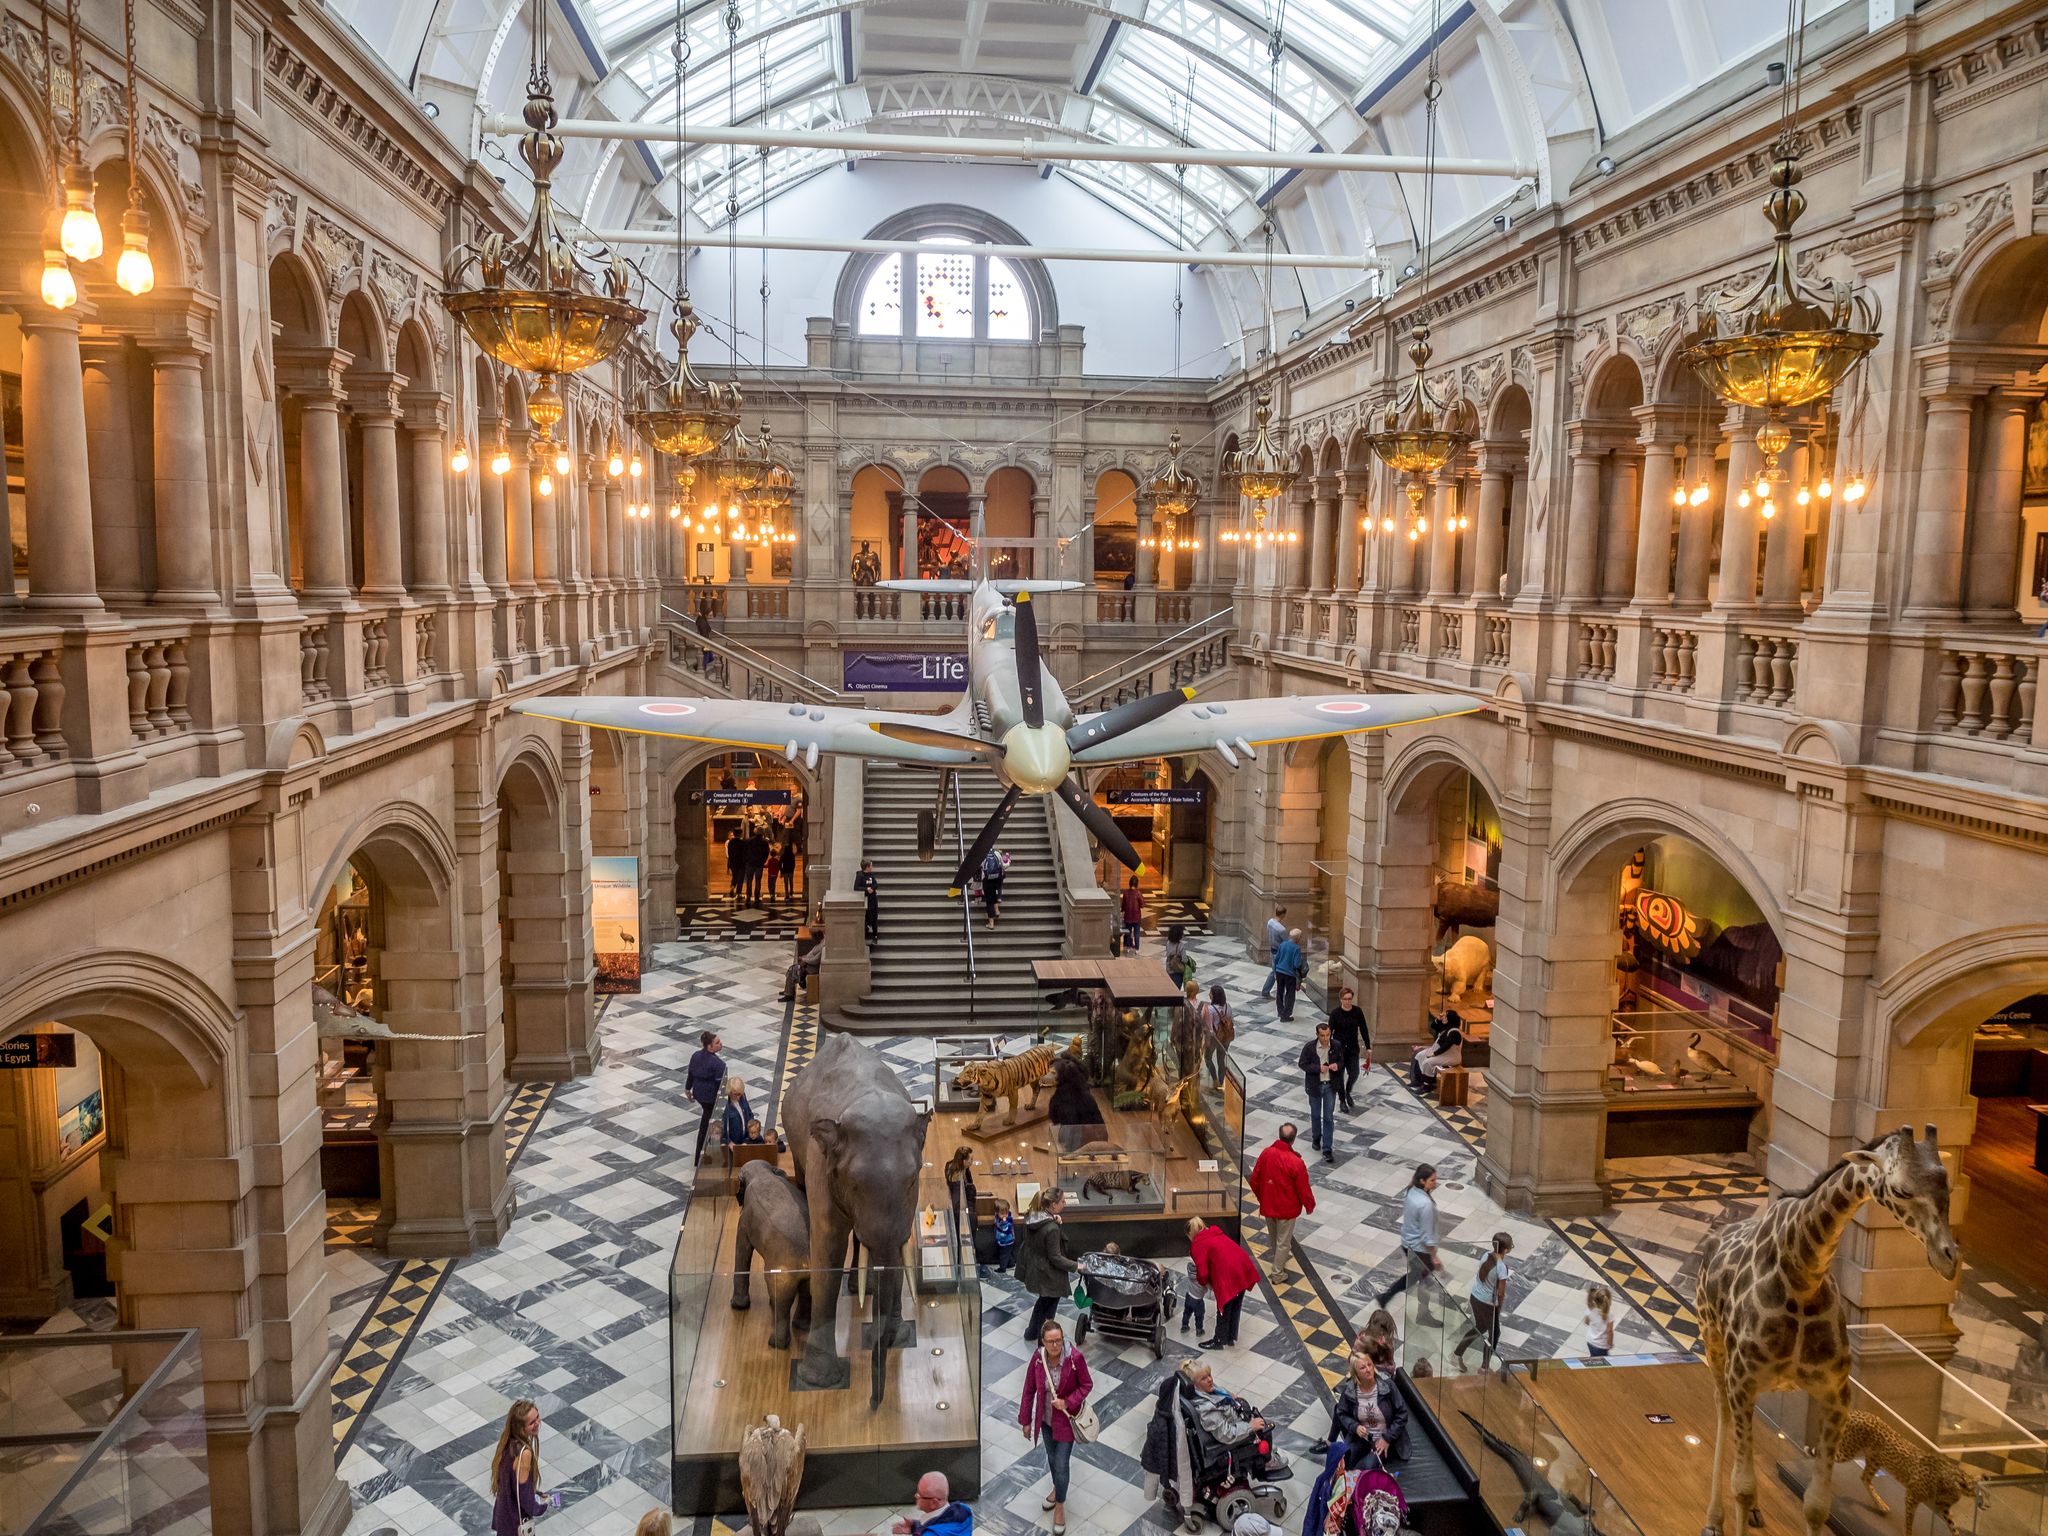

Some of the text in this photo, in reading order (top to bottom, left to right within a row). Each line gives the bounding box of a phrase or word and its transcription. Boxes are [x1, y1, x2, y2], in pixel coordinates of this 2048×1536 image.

[922, 656, 964, 679] Life
[2009, 1011, 2032, 1019] Centre
[0, 1041, 30, 1050] Stories
[5, 1054, 31, 1064] Egypt
